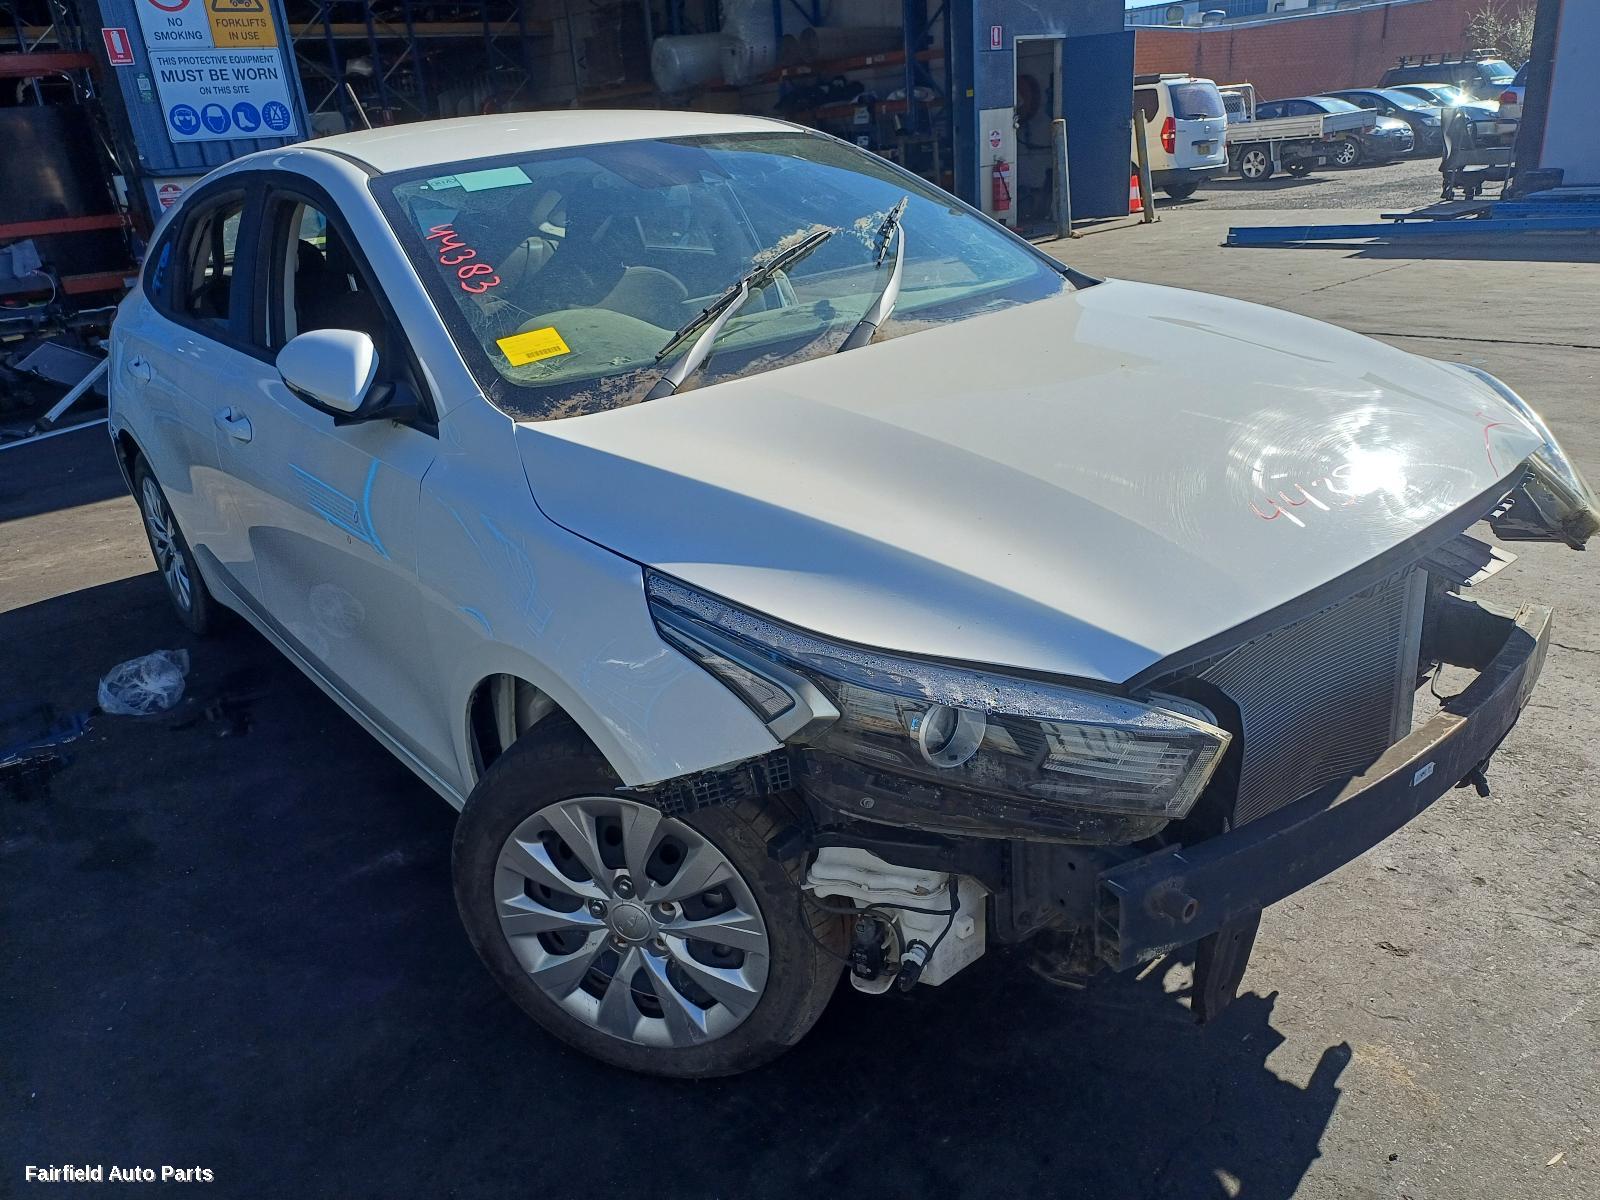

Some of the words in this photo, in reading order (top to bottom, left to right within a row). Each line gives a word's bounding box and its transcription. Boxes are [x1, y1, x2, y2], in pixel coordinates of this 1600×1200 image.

[168, 18, 183, 27] NO
[216, 18, 267, 28] FORKLIFTS
[154, 31, 203, 41] SMOKING
[229, 32, 239, 41] IN
[241, 31, 260, 40] USE
[157, 57, 177, 66] THIS
[178, 56, 228, 65] PROTECTIVE
[230, 55, 274, 64] EQUIPMENT
[160, 69, 204, 83] MUST
[208, 68, 230, 81] BE
[232, 67, 279, 81] WORN
[199, 86, 212, 95] ON
[213, 86, 231, 95] THIS
[233, 85, 250, 94] SITE
